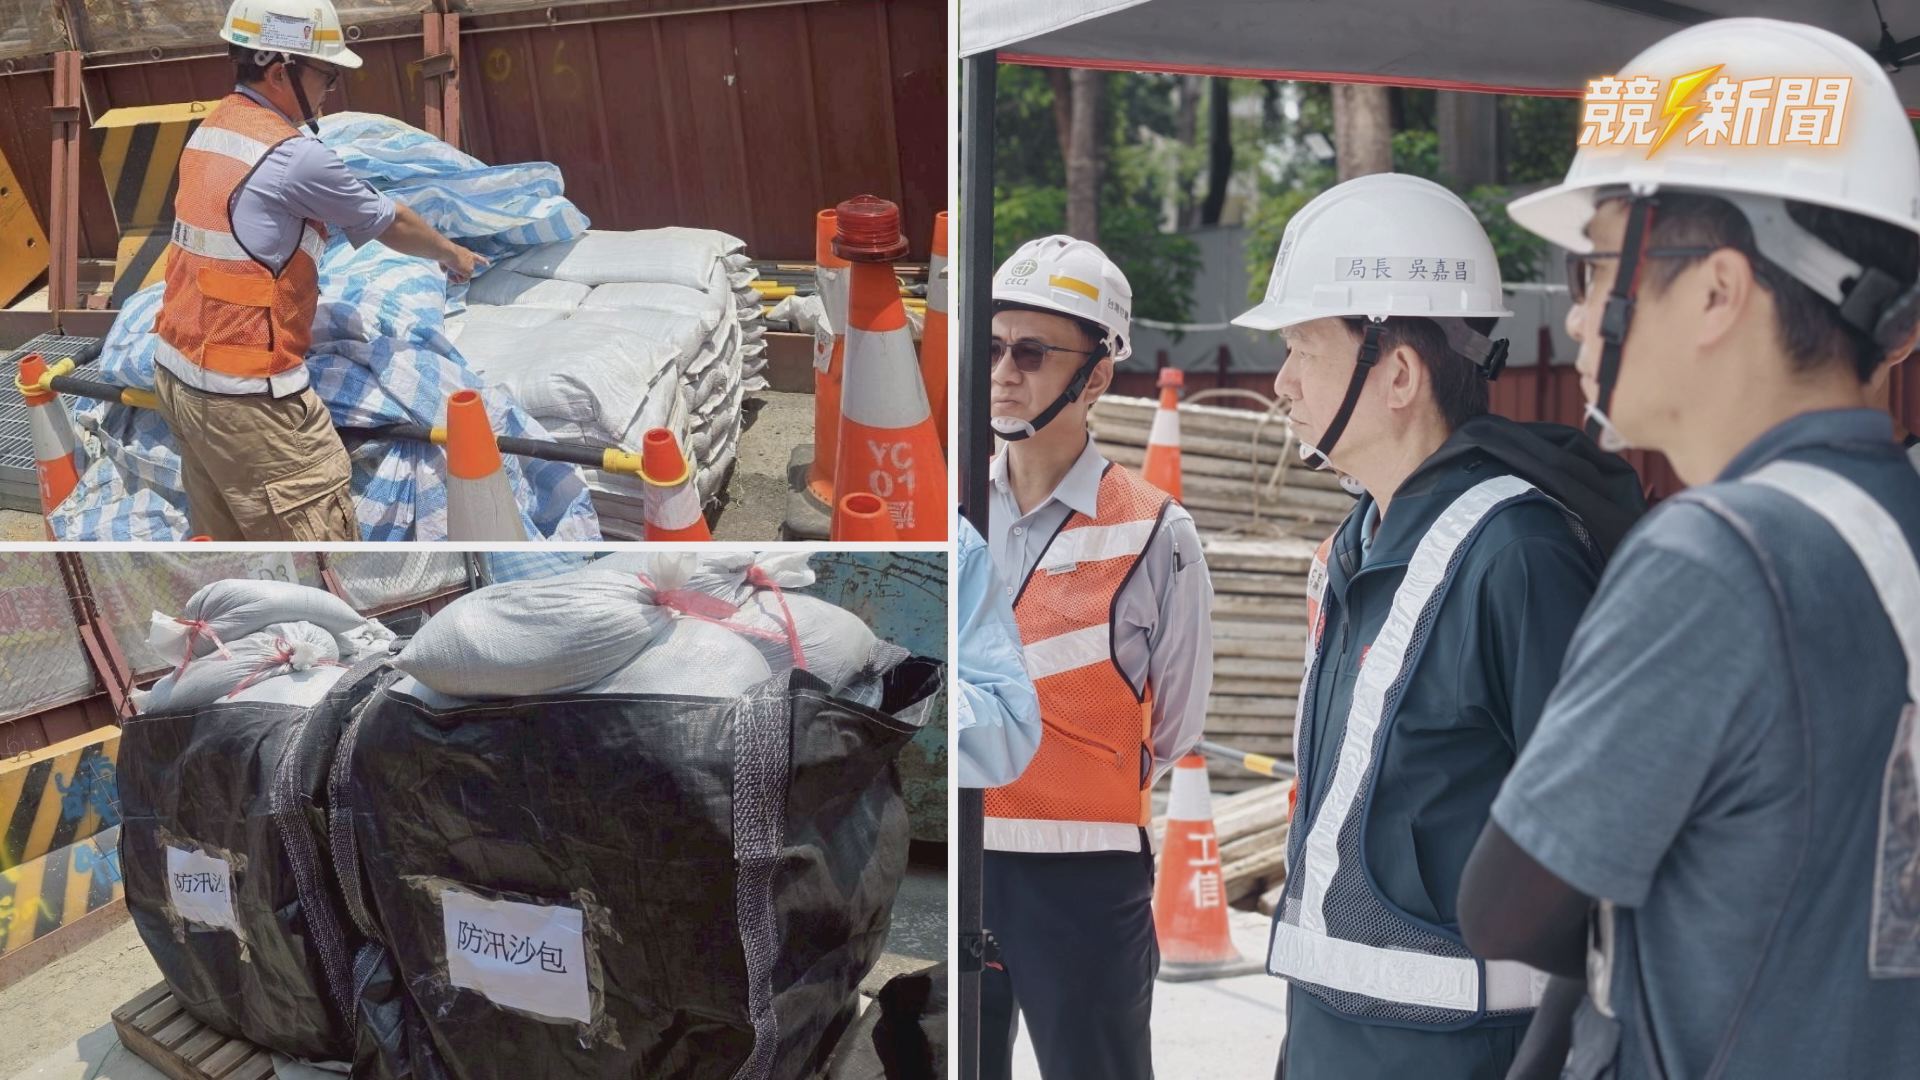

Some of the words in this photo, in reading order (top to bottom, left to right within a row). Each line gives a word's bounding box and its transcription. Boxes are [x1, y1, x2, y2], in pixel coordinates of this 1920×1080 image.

[1005, 277, 1029, 286] CECI
[1346, 257, 1393, 279] 局長
[1408, 257, 1468, 281] 吳嘉昌
[866, 440, 913, 469] YC
[869, 469, 916, 497] 01
[1187, 832, 1220, 909] 工信
[457, 920, 568, 974] 防汛沙包
